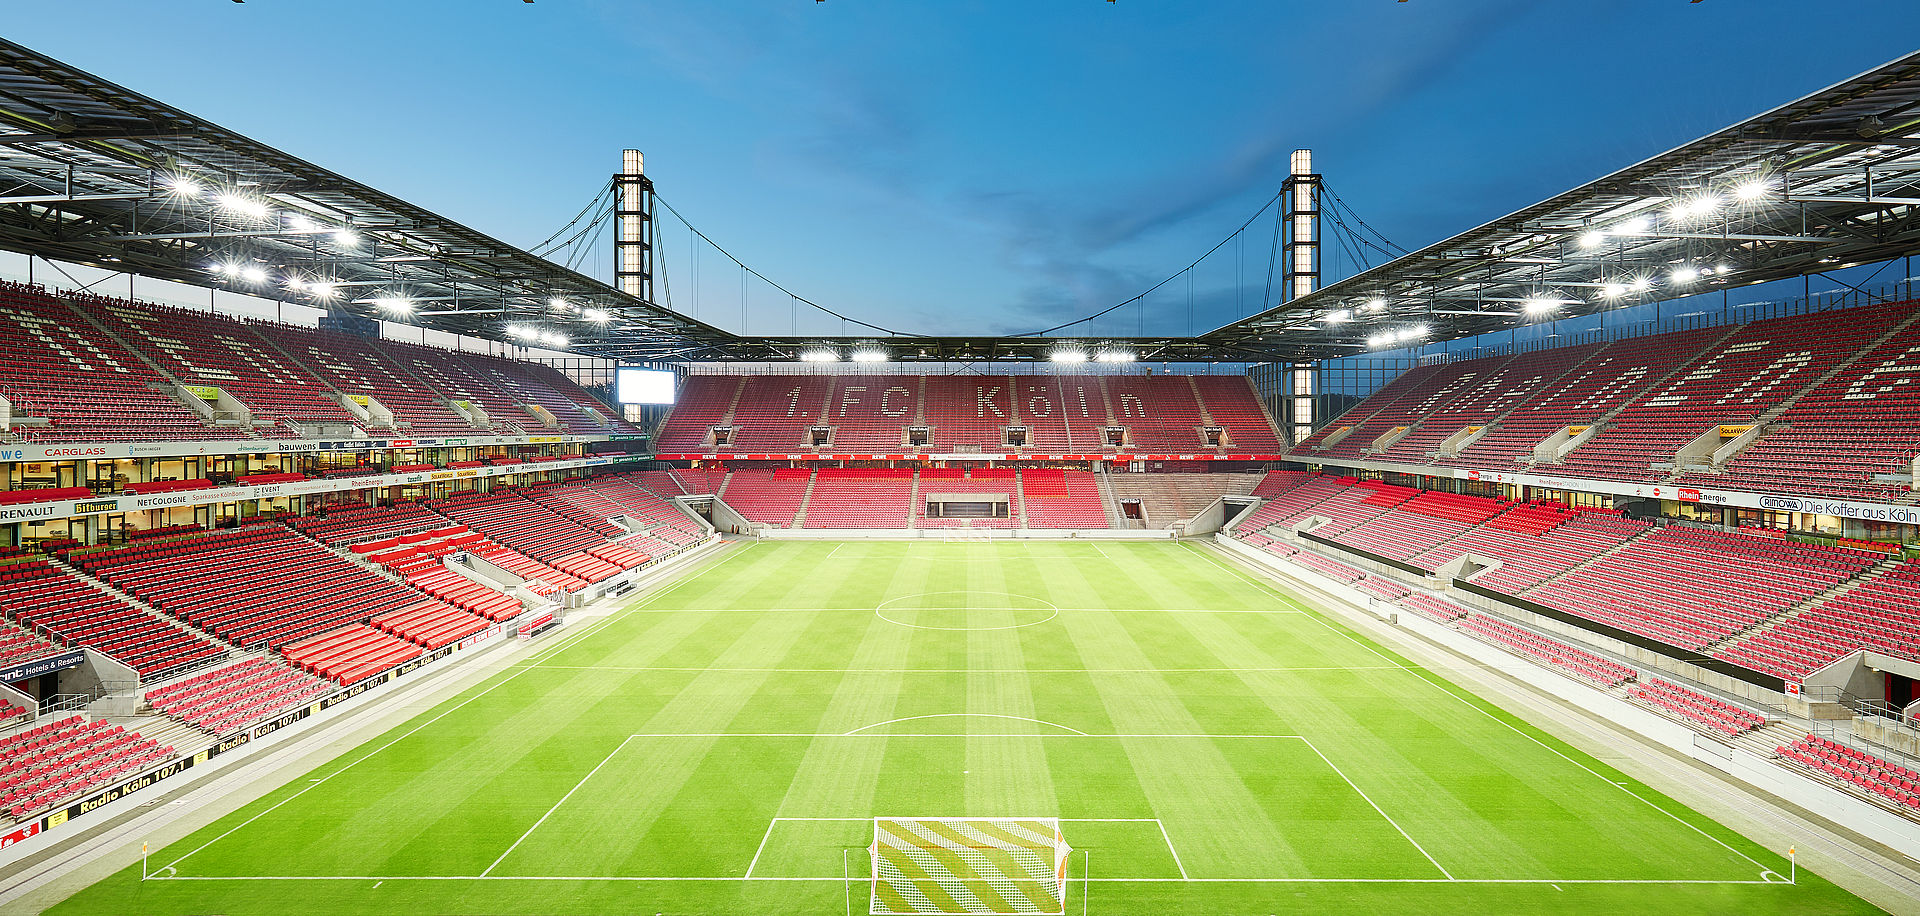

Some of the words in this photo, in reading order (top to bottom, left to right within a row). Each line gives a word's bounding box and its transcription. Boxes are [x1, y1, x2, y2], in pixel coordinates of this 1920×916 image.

[977, 386, 1146, 417] Köln
[44, 447, 106, 456] CARGLASS
[279, 442, 317, 451] bauwens
[261, 485, 281, 493] EVENT
[192, 492, 220, 501] Sparkasse
[1679, 490, 1727, 503] RheinEnergie
[0, 506, 55, 519] RENAULT
[75, 501, 117, 514] Bitburger
[1764, 498, 1799, 509] RIMOWA
[1804, 501, 1823, 514] Die
[1825, 502, 1860, 517] Koffer
[1862, 508, 1886, 519] aus
[1889, 506, 1918, 522] Köln
[25, 663, 49, 675] Hotels
[50, 661, 56, 669] &
[57, 655, 84, 667] Resorts
[327, 691, 349, 707] Radio
[349, 683, 365, 698] Köln
[219, 734, 248, 752] Radio
[255, 723, 276, 738] Köln
[80, 790, 119, 814] Radio
[122, 776, 151, 796] Köln
